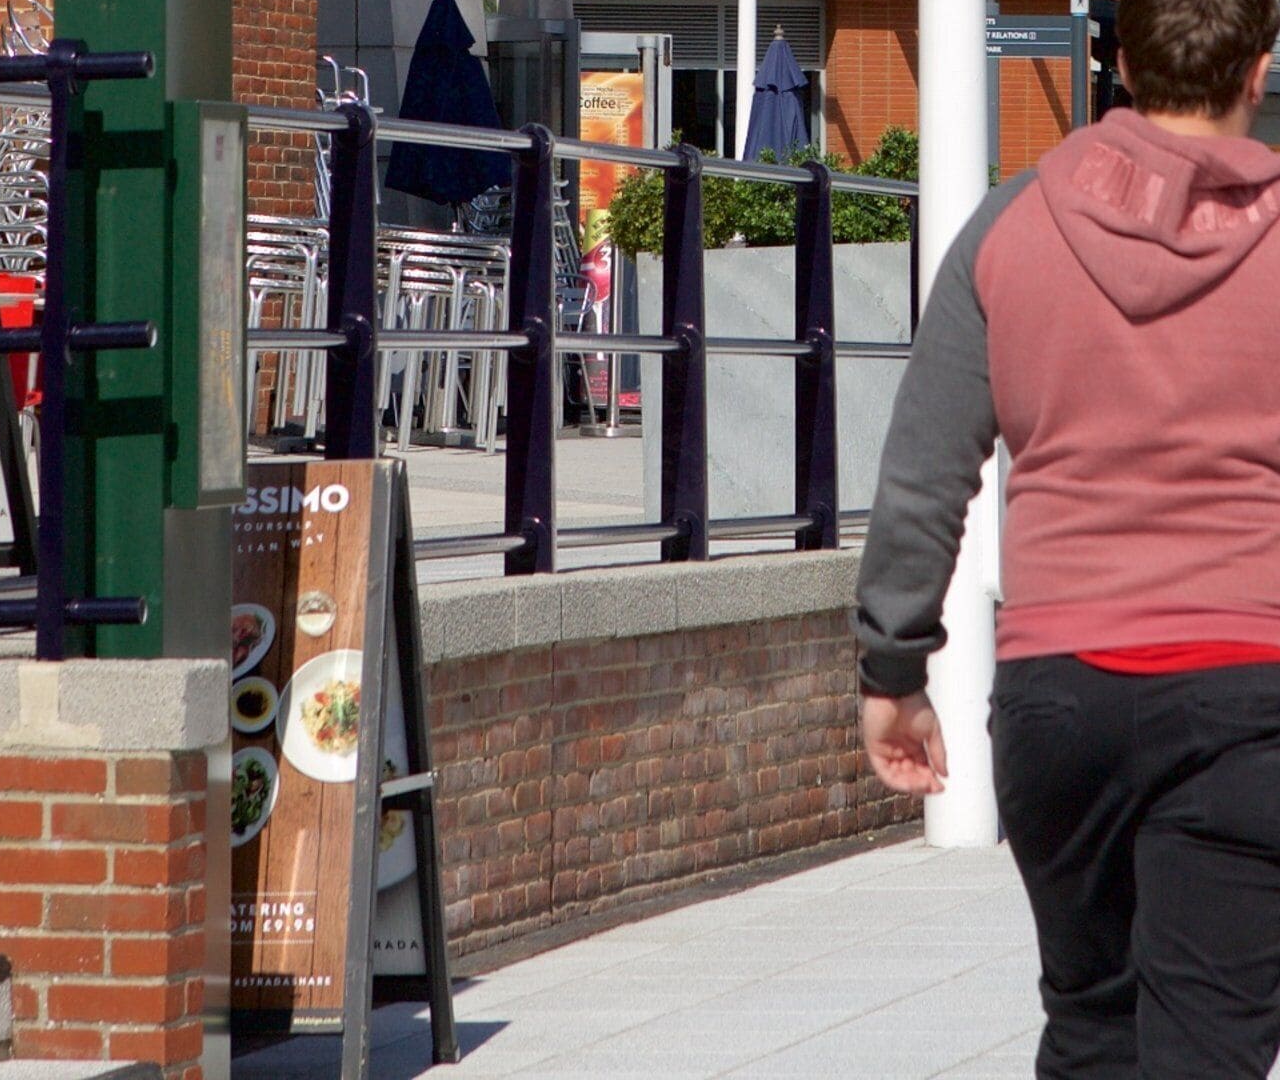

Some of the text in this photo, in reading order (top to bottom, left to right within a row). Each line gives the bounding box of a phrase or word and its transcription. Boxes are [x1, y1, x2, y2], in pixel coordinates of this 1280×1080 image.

[234, 520, 313, 533] YOURSELF
[290, 533, 324, 549] WAY
[262, 918, 316, 933] £9.95
[373, 938, 420, 951] RADA
[234, 976, 332, 988] #STRADASHARE
